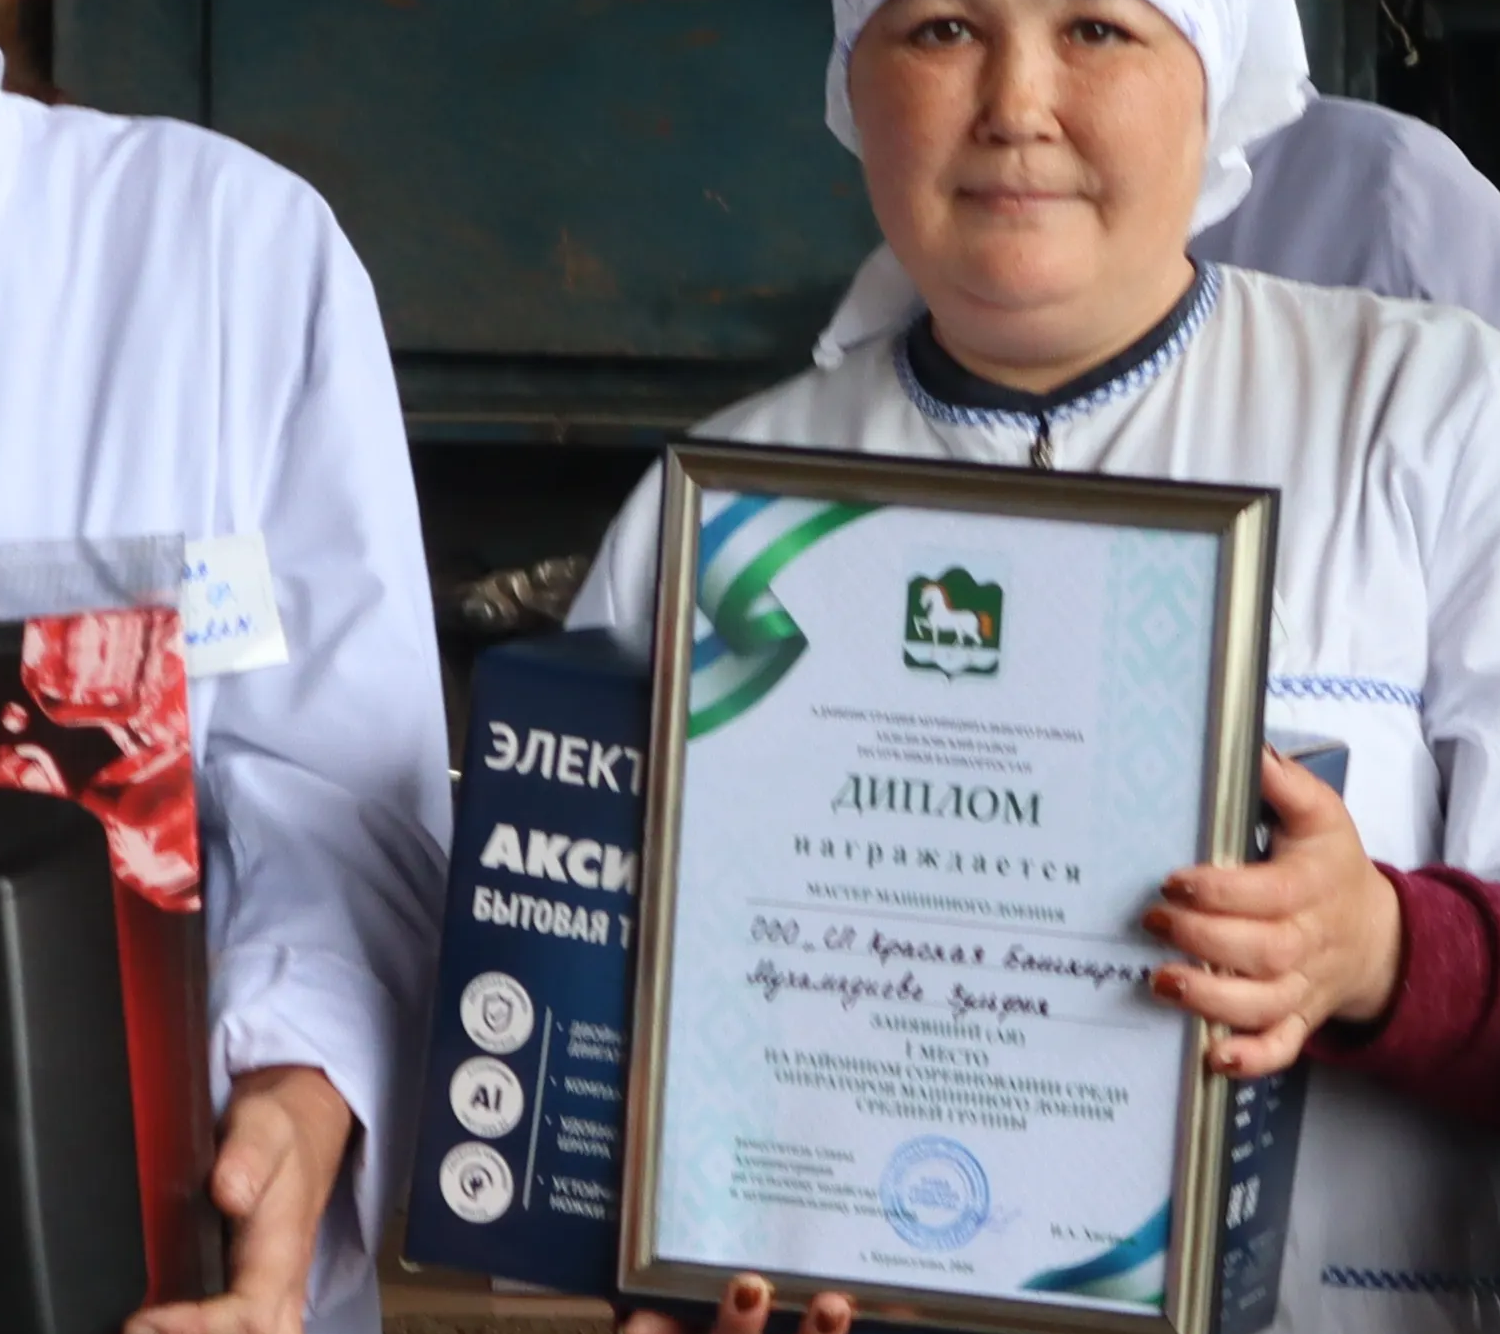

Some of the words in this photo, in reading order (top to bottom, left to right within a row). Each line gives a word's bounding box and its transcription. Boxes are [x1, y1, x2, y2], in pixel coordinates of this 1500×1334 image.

[830, 771, 1043, 827] ДИПЛОМ
[794, 834, 1082, 885] награждается
[473, 885, 609, 946] БЫТОВАЯ
[919, 1043, 990, 1068] МЕСТО
